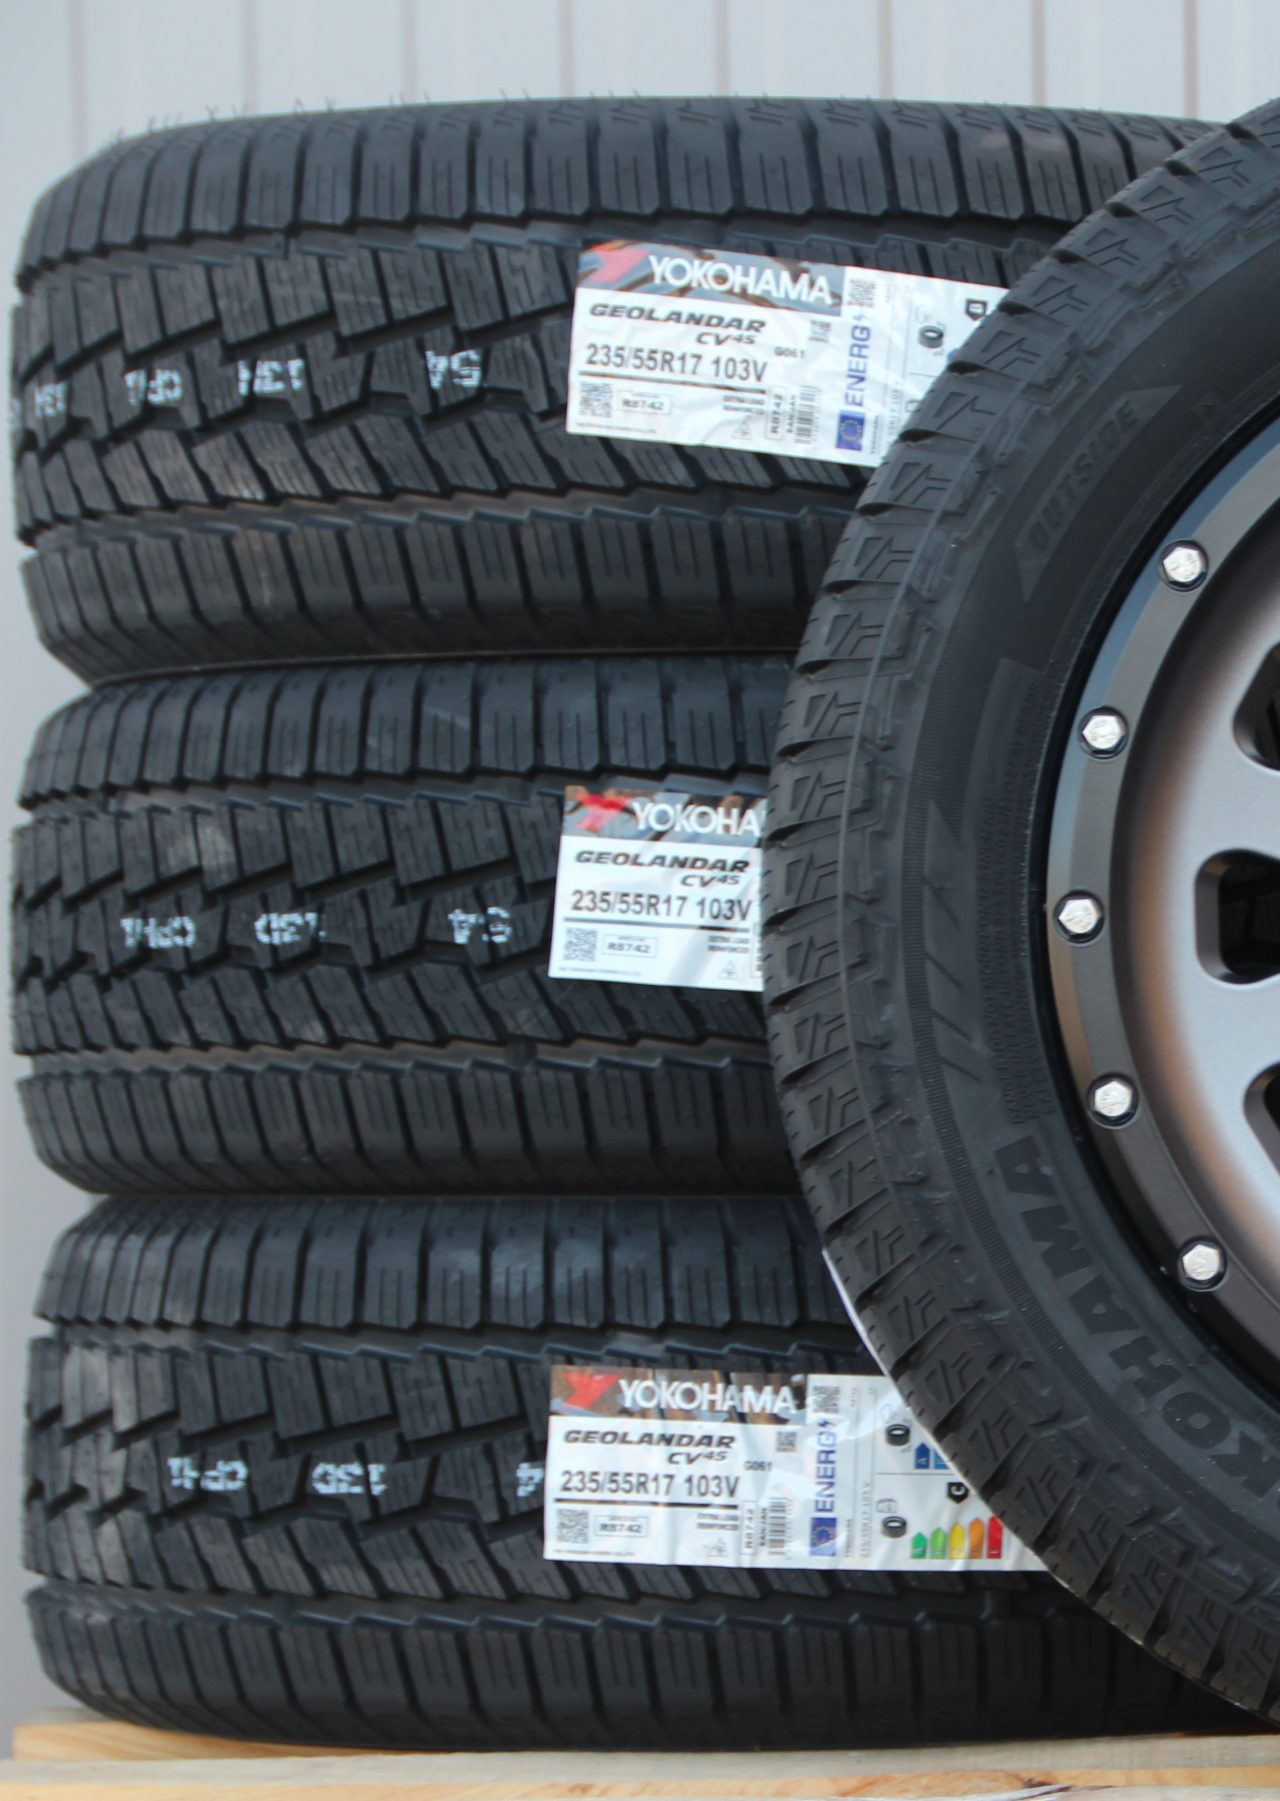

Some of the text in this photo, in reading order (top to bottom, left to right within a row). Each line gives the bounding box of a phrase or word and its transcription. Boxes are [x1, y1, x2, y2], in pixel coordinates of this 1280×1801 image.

[648, 255, 832, 306] YOKOHAMA
[590, 303, 766, 333] GEOLANDAR
[586, 343, 767, 383] 235/55R17 103V
[632, 802, 766, 838] YOKOHA
[575, 850, 749, 873] GEOLANDAR
[571, 889, 752, 921] 235/55R17 103V
[619, 1379, 796, 1414] YOKOHAMA
[564, 1430, 736, 1449] GEOLANDAR
[560, 1470, 740, 1498] 235/55R17 103V
[815, 1431, 836, 1513] ENERG
[951, 1485, 966, 1497] C
